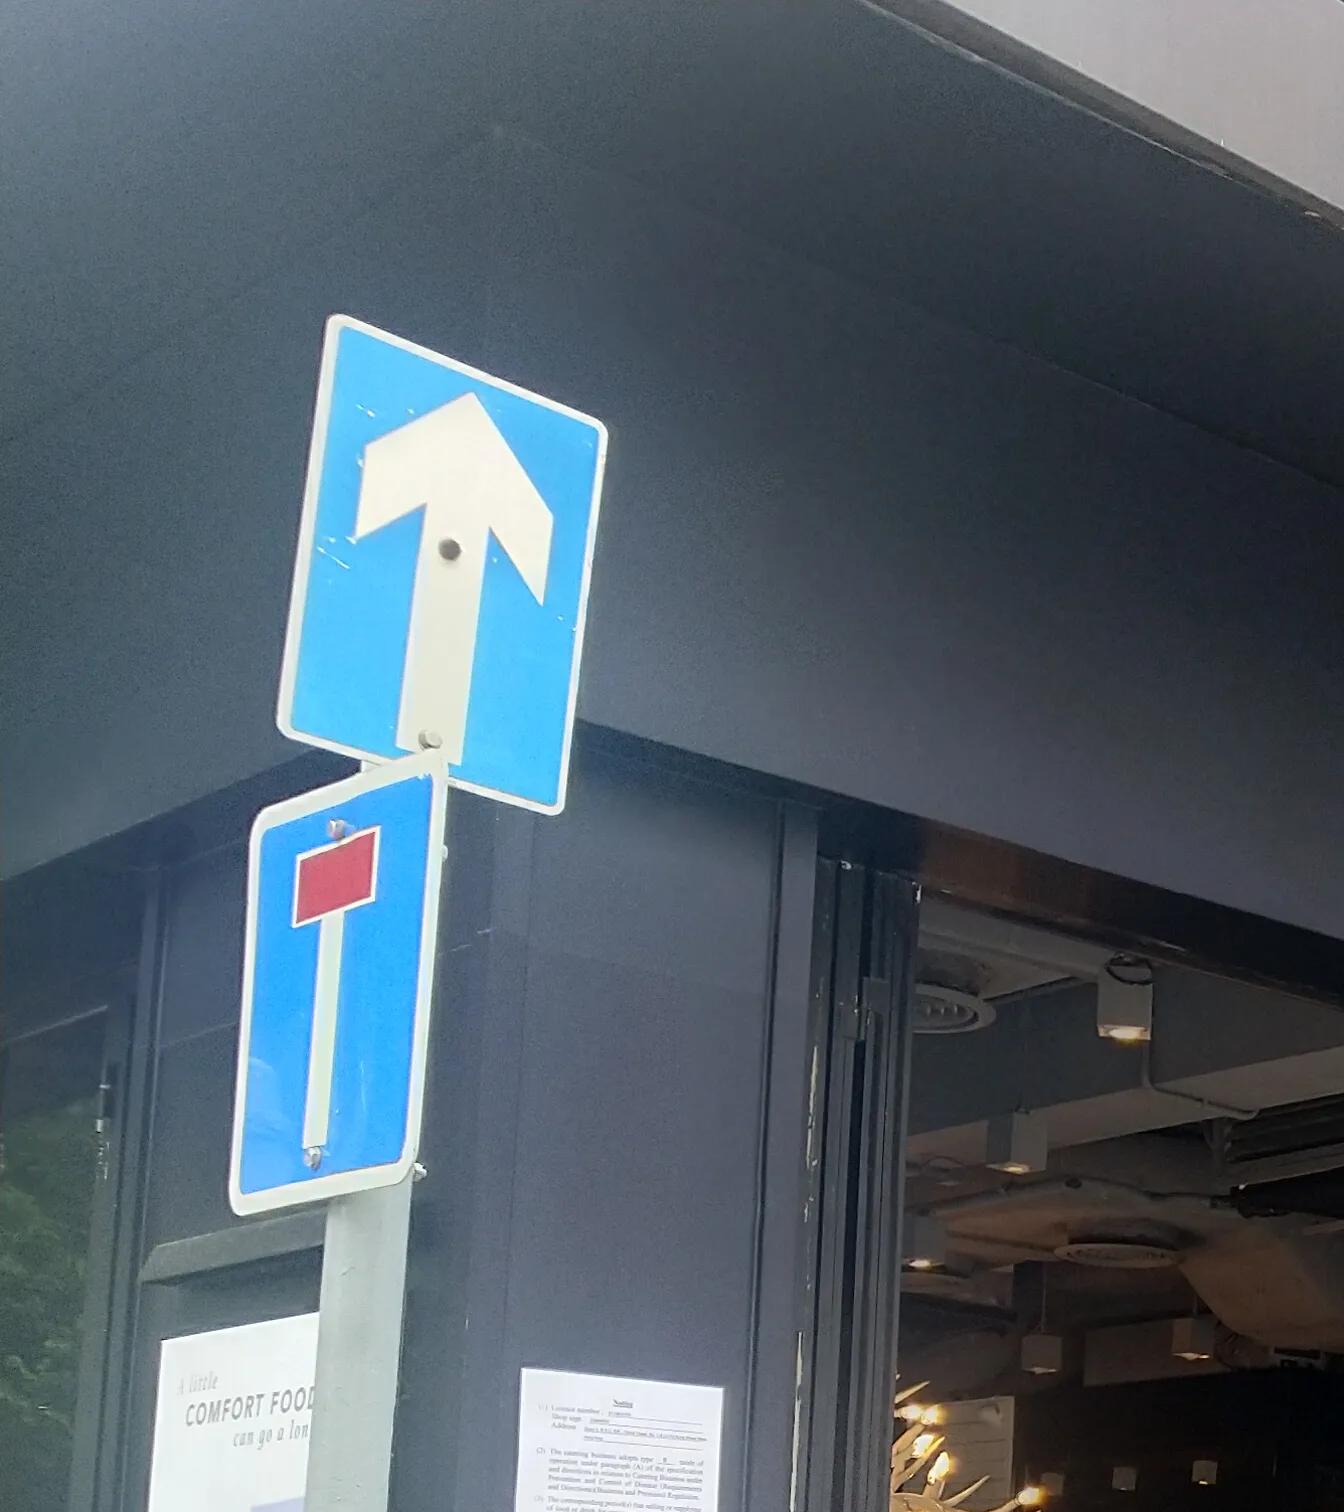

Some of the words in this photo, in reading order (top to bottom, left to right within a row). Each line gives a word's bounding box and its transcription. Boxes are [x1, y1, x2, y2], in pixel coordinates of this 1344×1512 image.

[188, 1370, 220, 1396] little
[185, 1392, 265, 1427] COMFORT
[232, 1430, 255, 1448] can
[257, 1427, 273, 1451] go
[276, 1425, 286, 1442] a
[288, 1419, 310, 1442] lon
